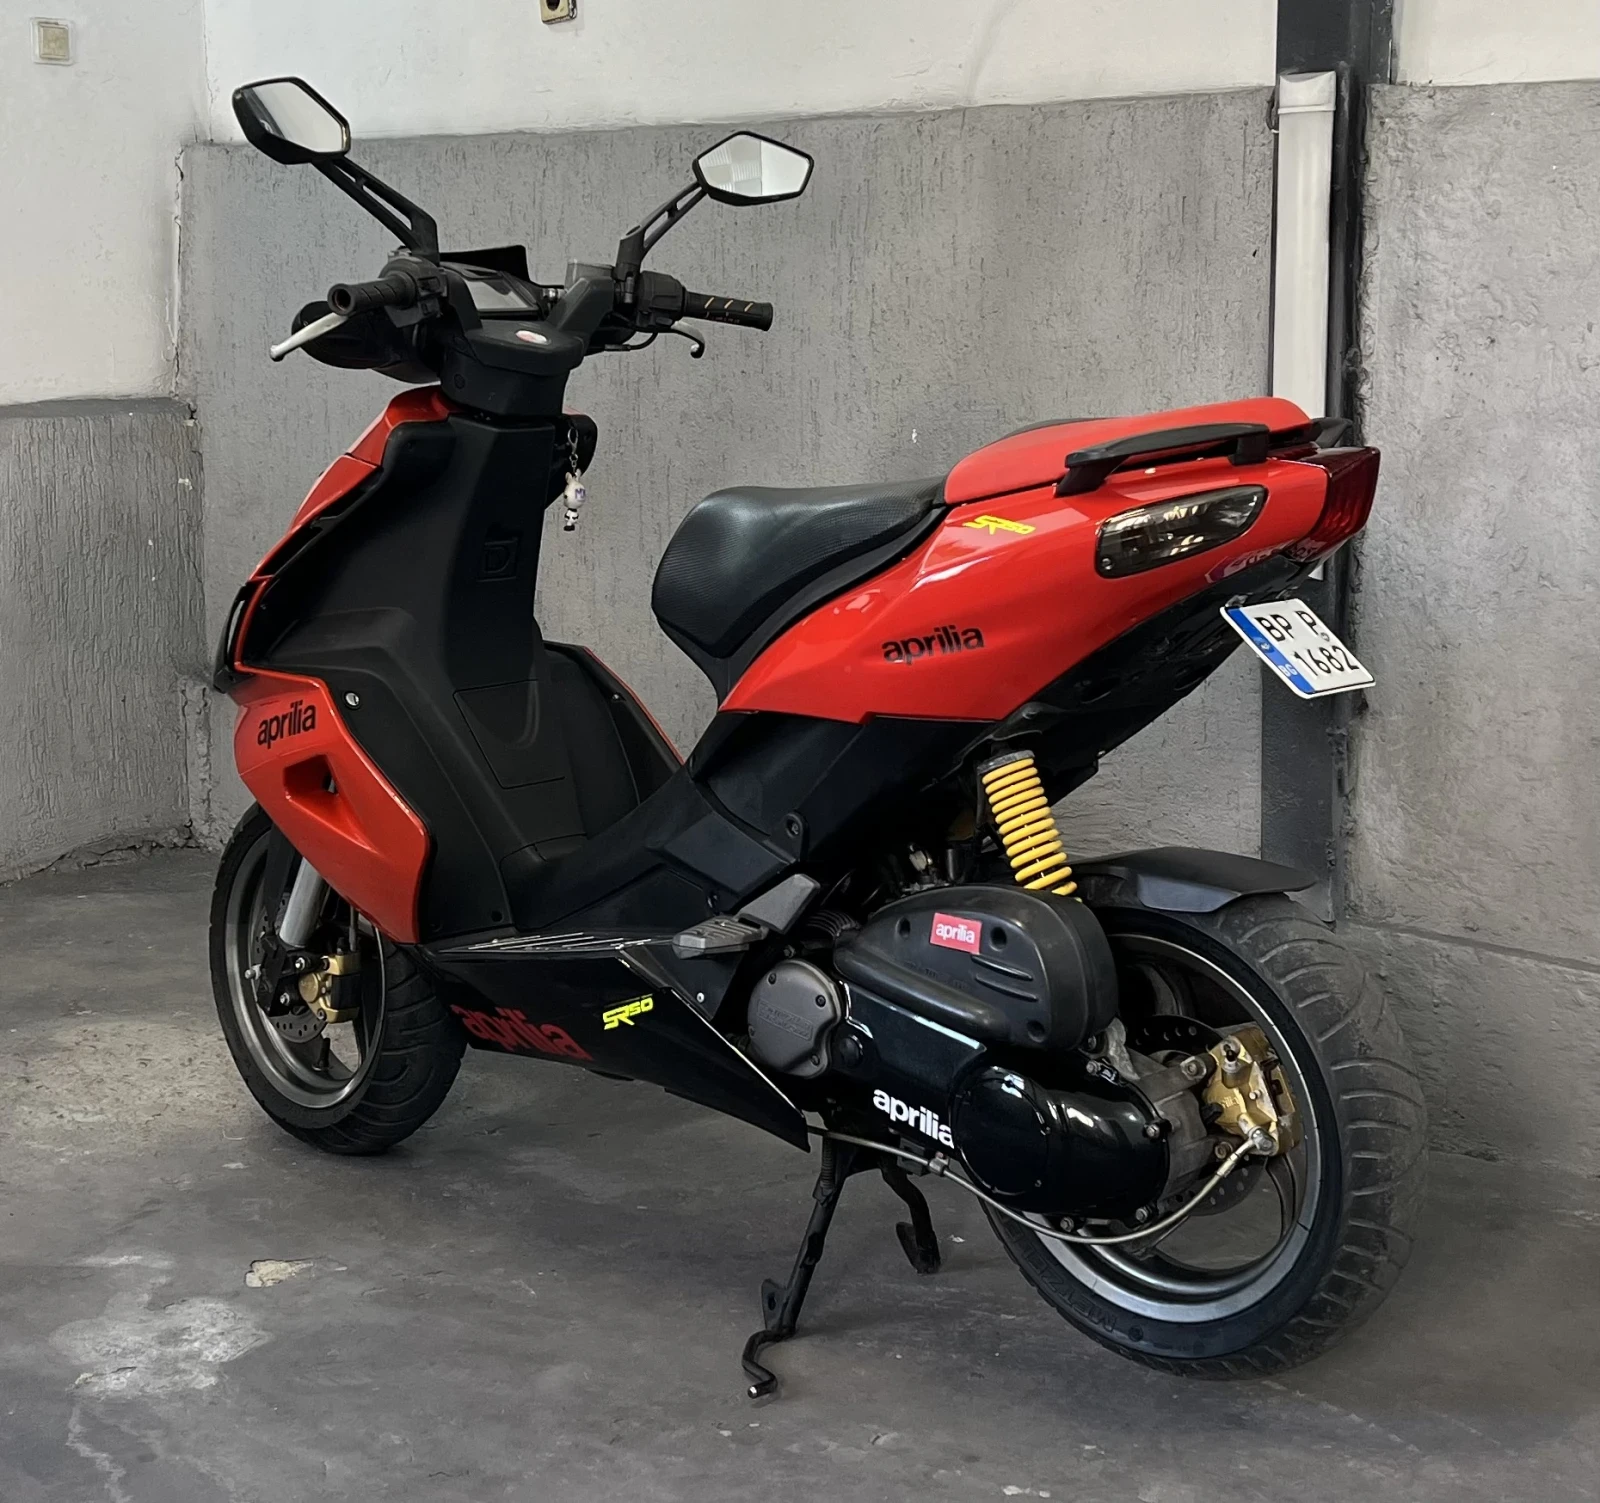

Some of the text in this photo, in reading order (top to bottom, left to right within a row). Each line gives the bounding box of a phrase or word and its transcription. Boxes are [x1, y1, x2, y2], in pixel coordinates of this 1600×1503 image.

[881, 625, 985, 665] aprilia
[1254, 610, 1318, 641] BP P
[1293, 645, 1360, 676] 1682
[257, 700, 316, 749] aprilia
[935, 923, 976, 944] aprilia
[450, 1004, 595, 1061] aprilia
[873, 1089, 955, 1149] aprilia
